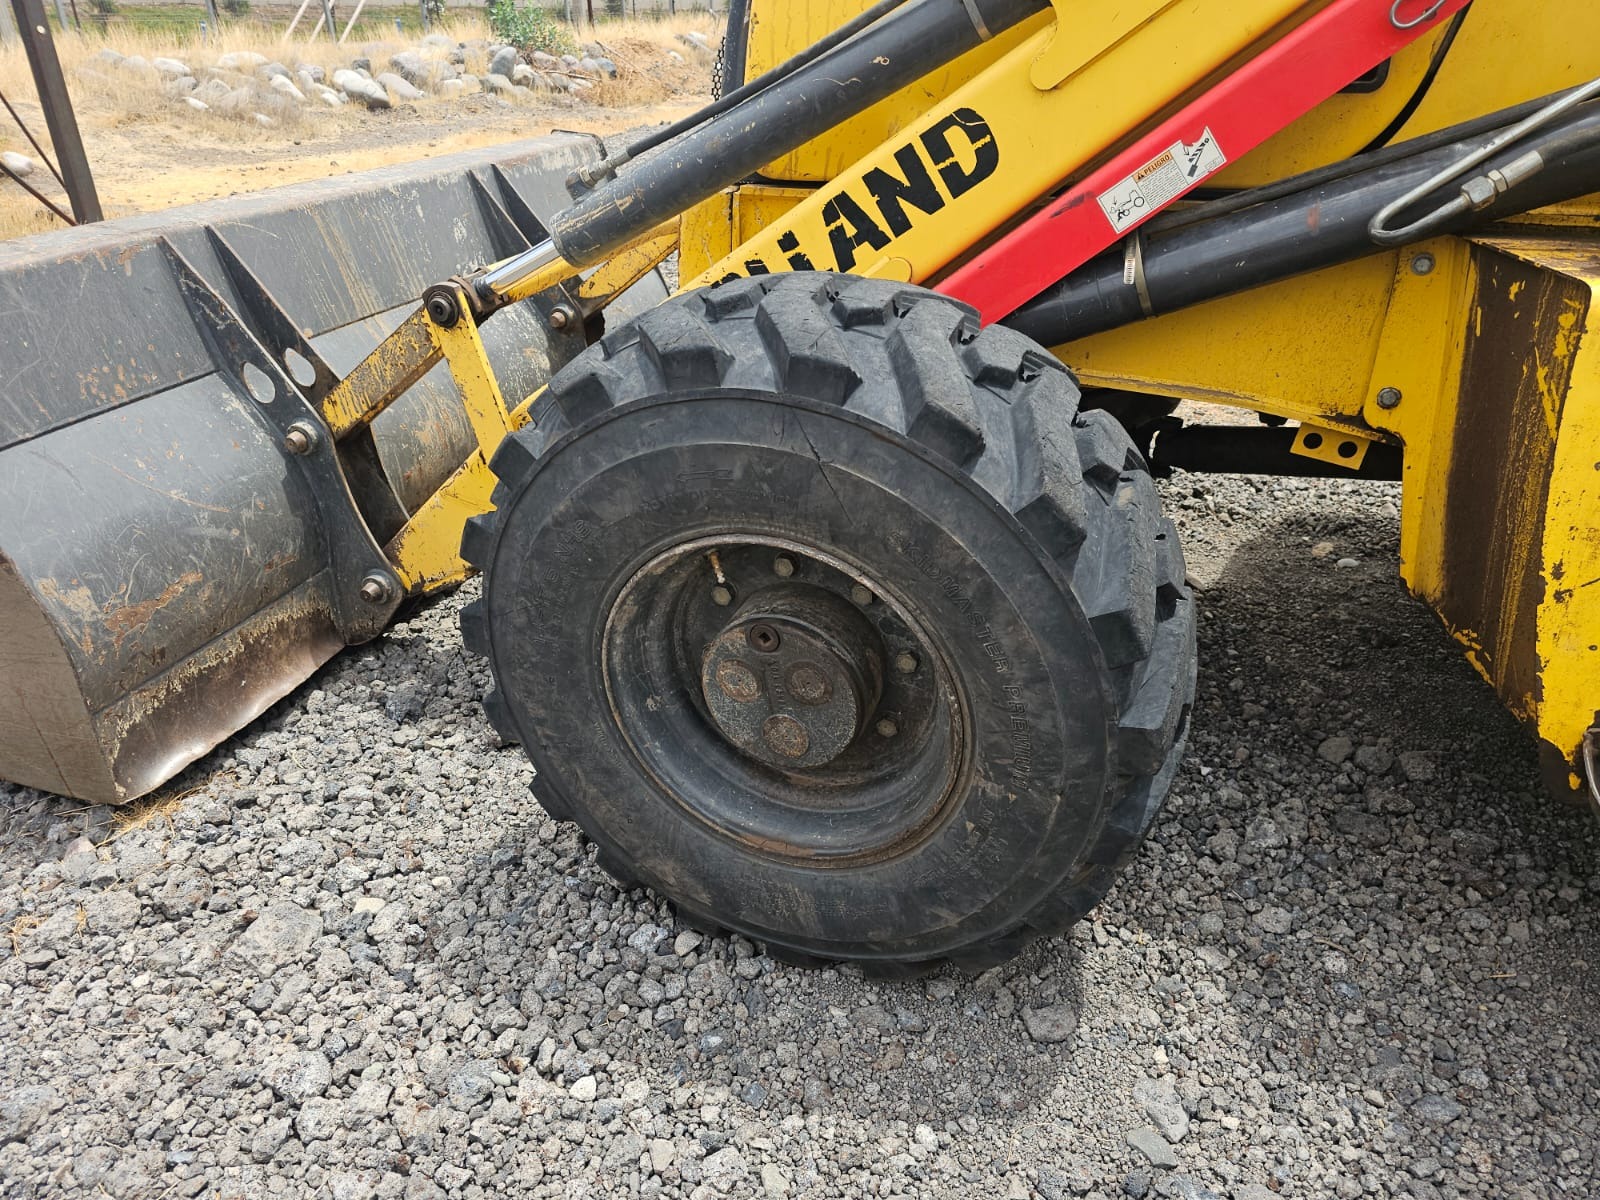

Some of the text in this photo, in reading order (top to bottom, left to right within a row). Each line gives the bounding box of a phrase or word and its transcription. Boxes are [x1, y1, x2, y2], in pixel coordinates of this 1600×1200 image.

[1143, 154, 1171, 175] PELIGRO
[887, 530, 1033, 791] SKIDMASTER PREMIUM
